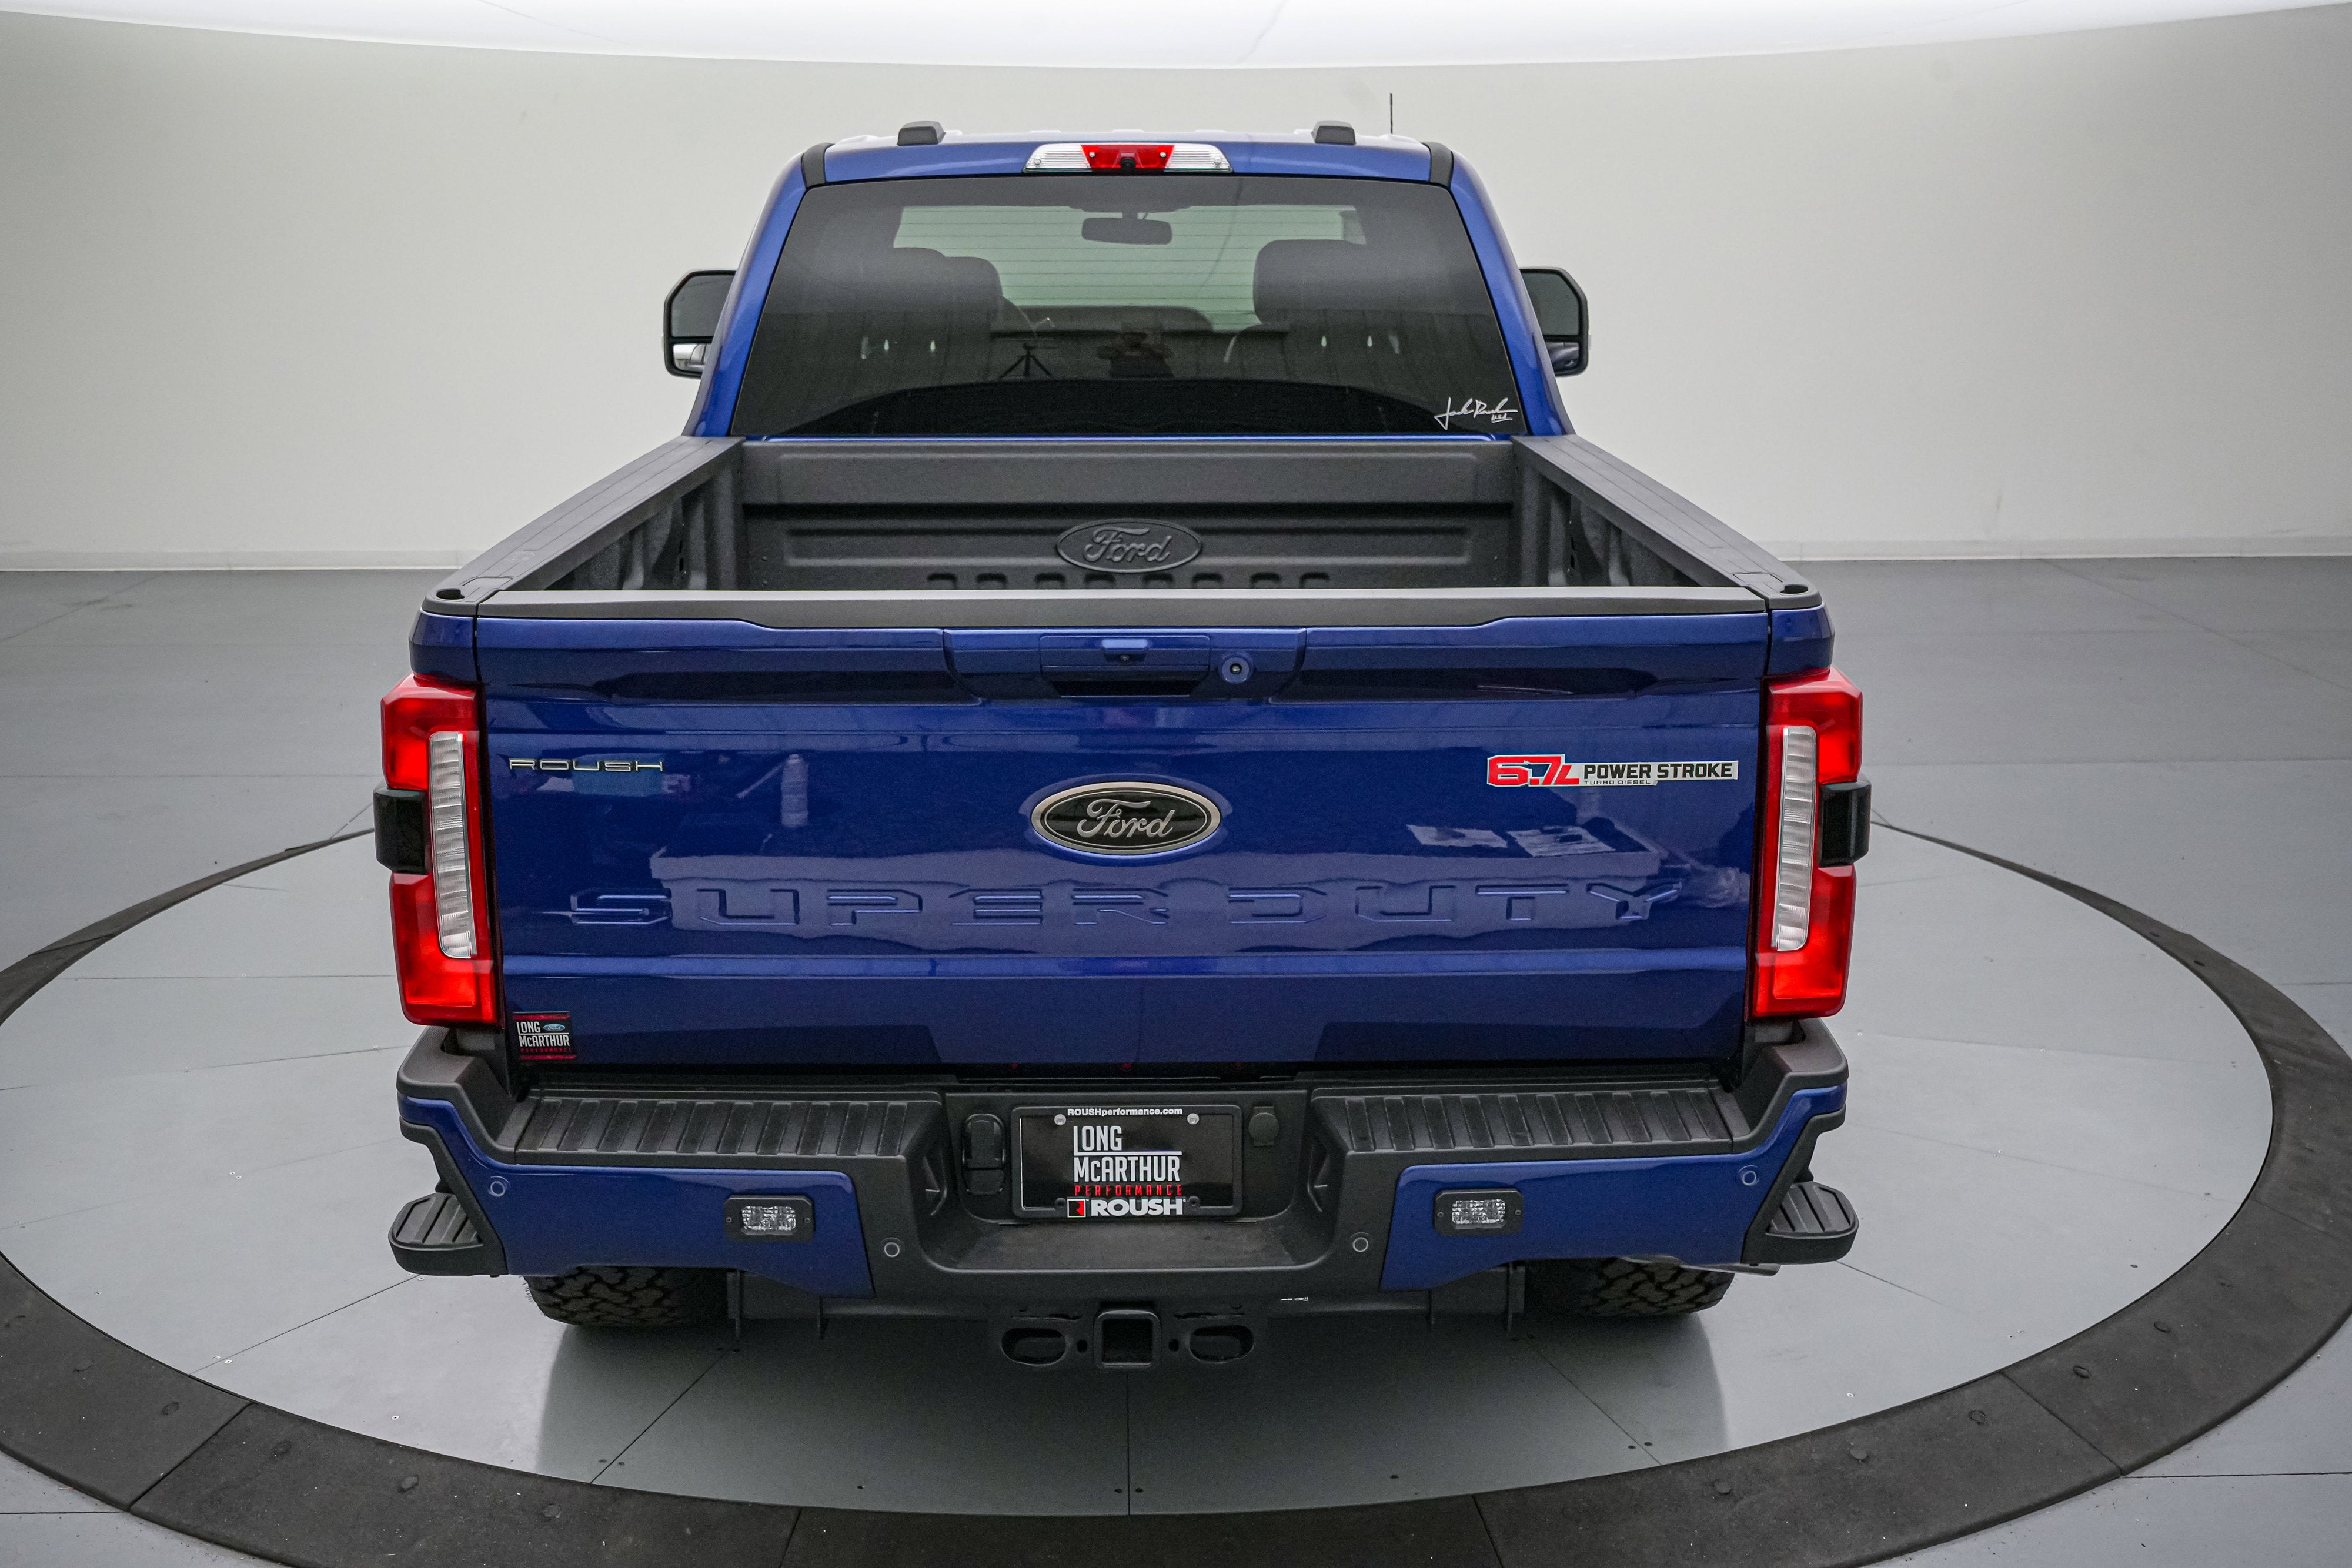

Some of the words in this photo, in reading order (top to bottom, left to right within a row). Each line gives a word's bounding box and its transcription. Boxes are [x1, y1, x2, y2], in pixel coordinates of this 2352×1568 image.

[1084, 527, 1172, 562] Ford
[509, 758, 663, 772] ROUSH
[1488, 756, 1580, 785] 6.7L
[1584, 764, 1651, 779] POWER
[1657, 763, 1733, 778] STROKE
[1077, 798, 1175, 838] Ford
[570, 888, 1169, 925] SUPER
[1228, 882, 1681, 924] DUTY
[517, 1022, 540, 1035] LONG
[519, 1035, 570, 1047] McARTHUR
[1067, 1108, 1183, 1116] ROUSHperformance.com
[1073, 1125, 1122, 1155] LONG
[1074, 1156, 1180, 1182] McARTHUR
[1074, 1183, 1182, 1196] PERFORMANCE
